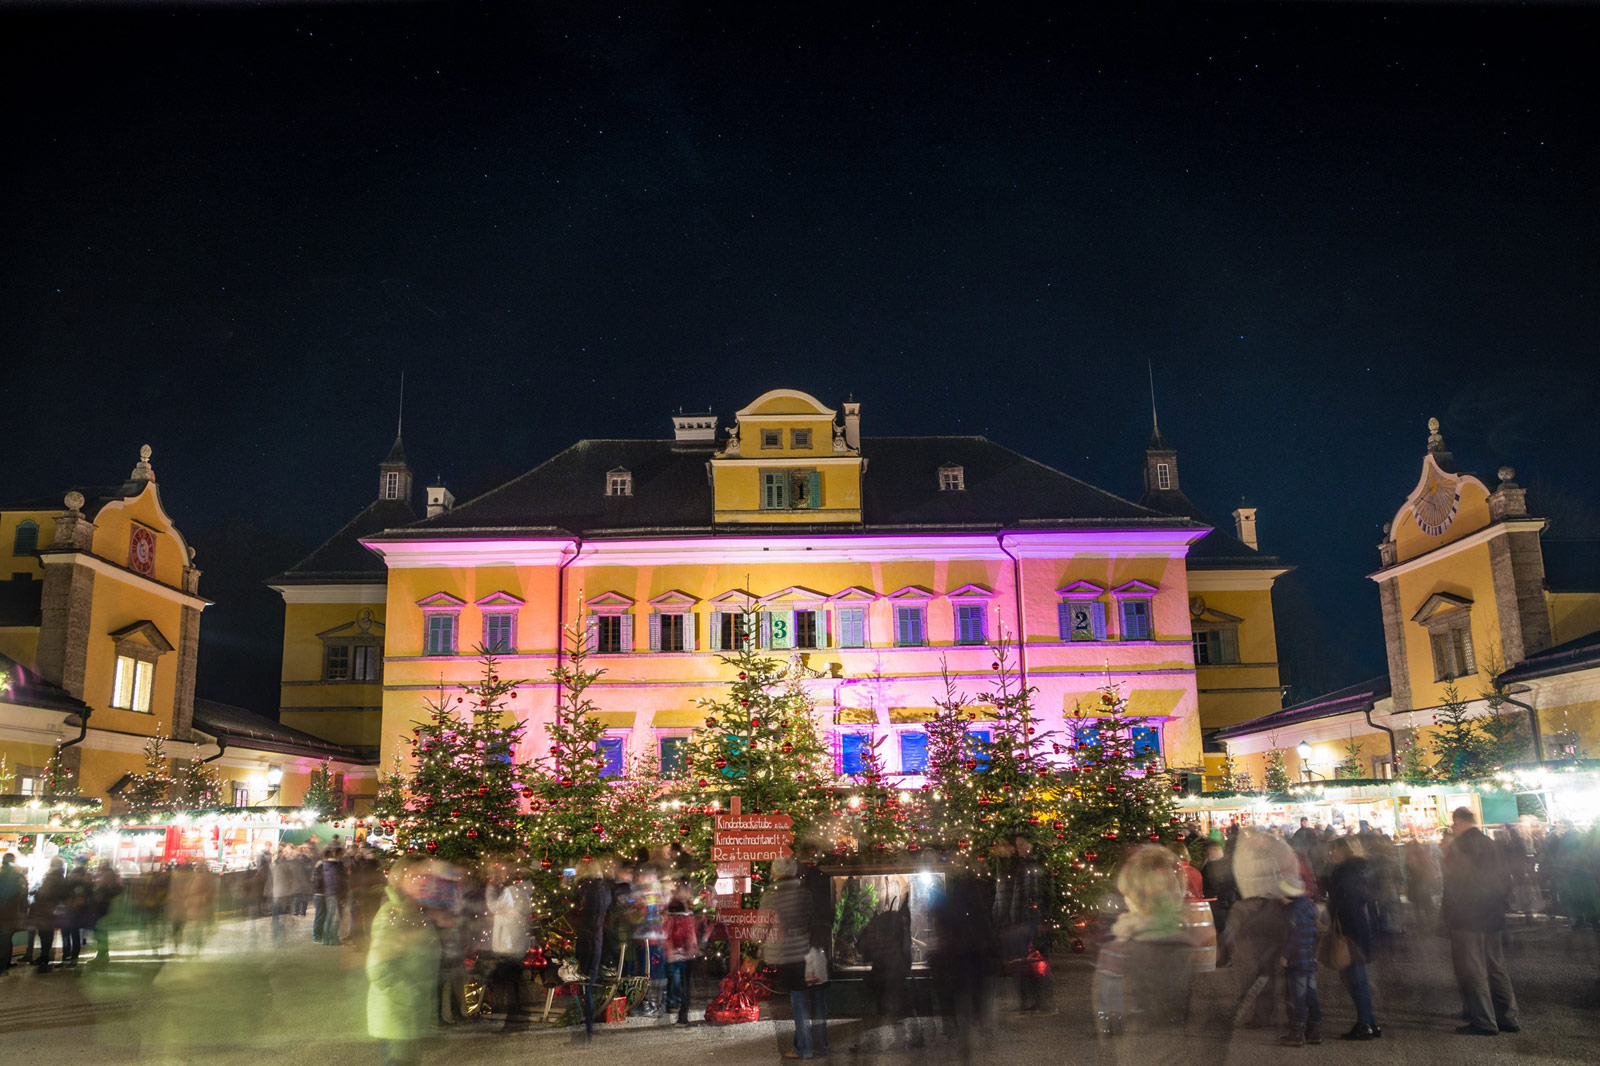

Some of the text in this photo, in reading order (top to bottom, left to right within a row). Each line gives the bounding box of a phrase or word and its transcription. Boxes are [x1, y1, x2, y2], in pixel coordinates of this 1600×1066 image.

[1075, 611, 1088, 630] 2
[774, 620, 787, 639] 3
[717, 815, 772, 829] Kinderbackstube
[713, 847, 784, 861] Restaurant
[758, 912, 770, 924] und
[734, 926, 779, 940] BANKOMAT
